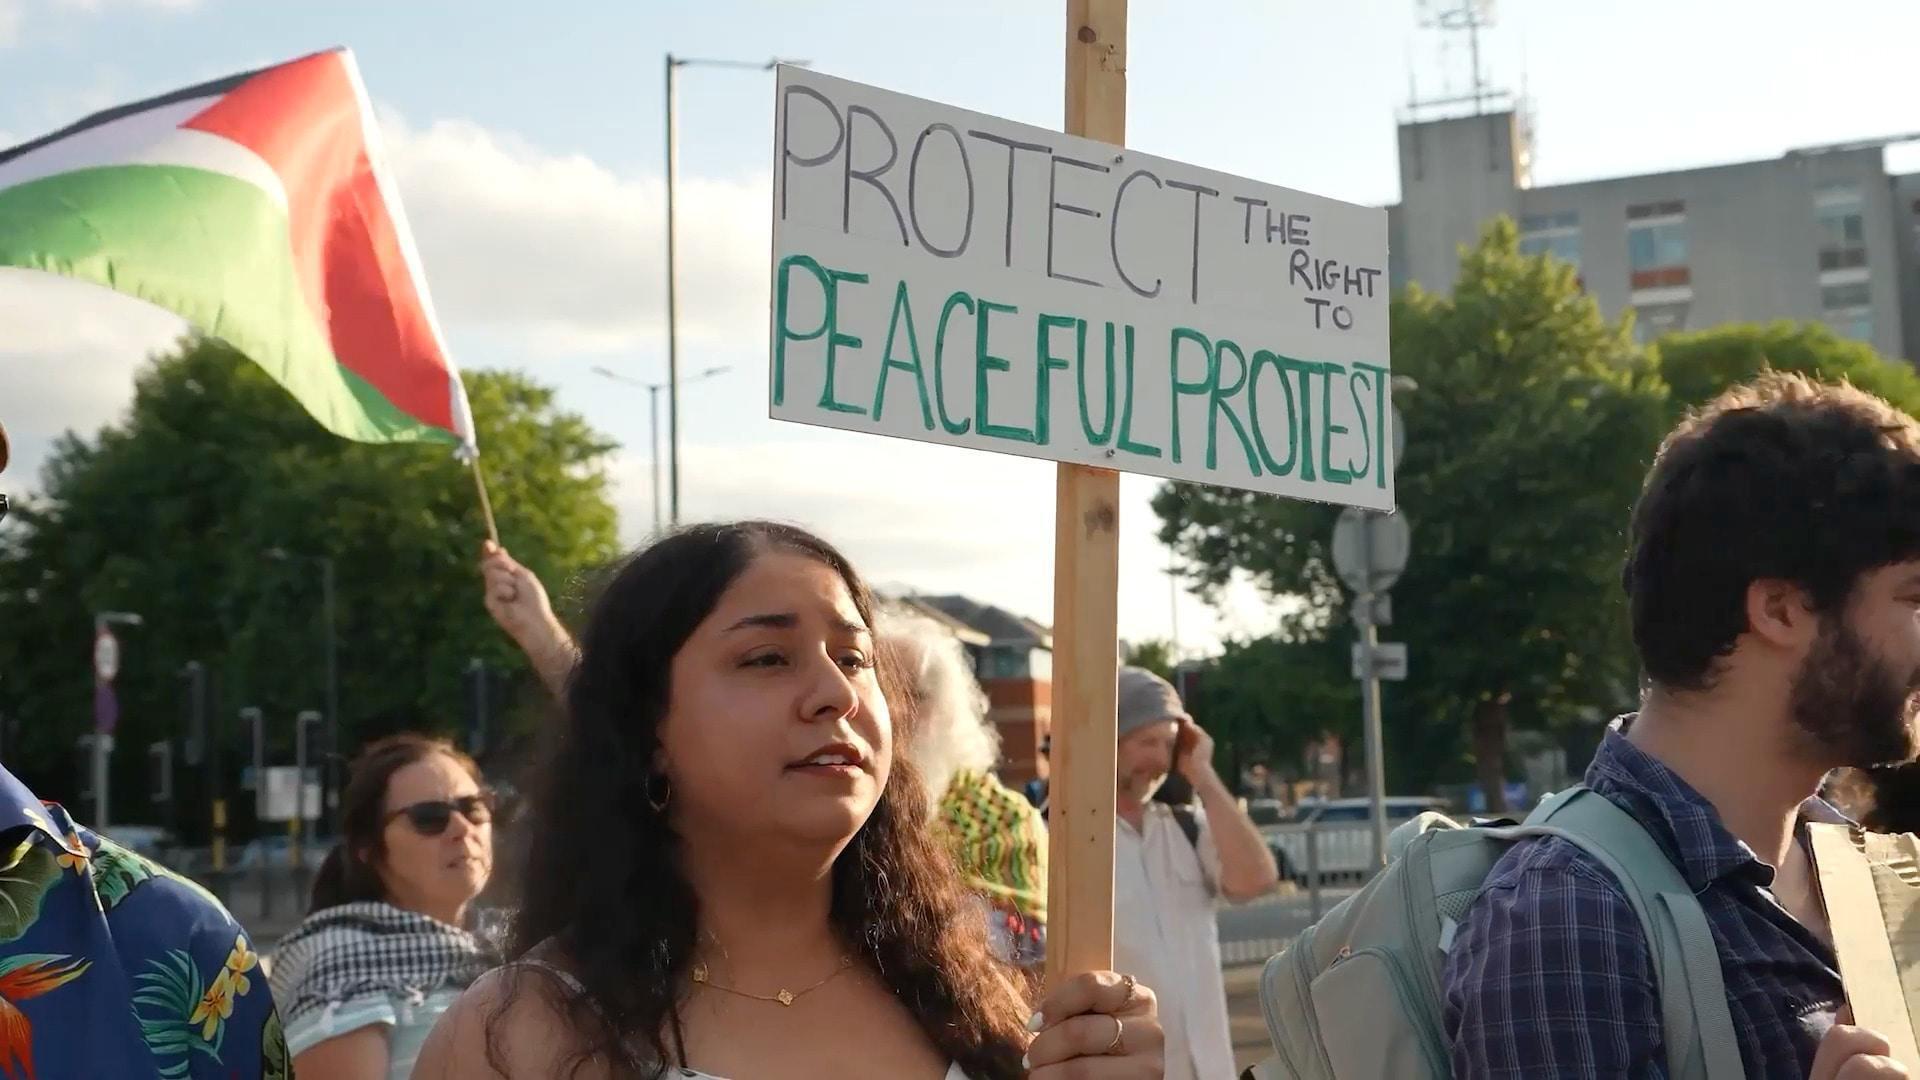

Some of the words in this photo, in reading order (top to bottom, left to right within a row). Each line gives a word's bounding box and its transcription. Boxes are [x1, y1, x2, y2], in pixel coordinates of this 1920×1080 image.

[782, 84, 1219, 304] PROTECT
[1233, 196, 1311, 245] THE
[1289, 249, 1382, 299] RIGHT
[1304, 297, 1354, 331] TO
[773, 254, 1162, 457] PEACEFUL
[1171, 327, 1391, 489] PROTEST
